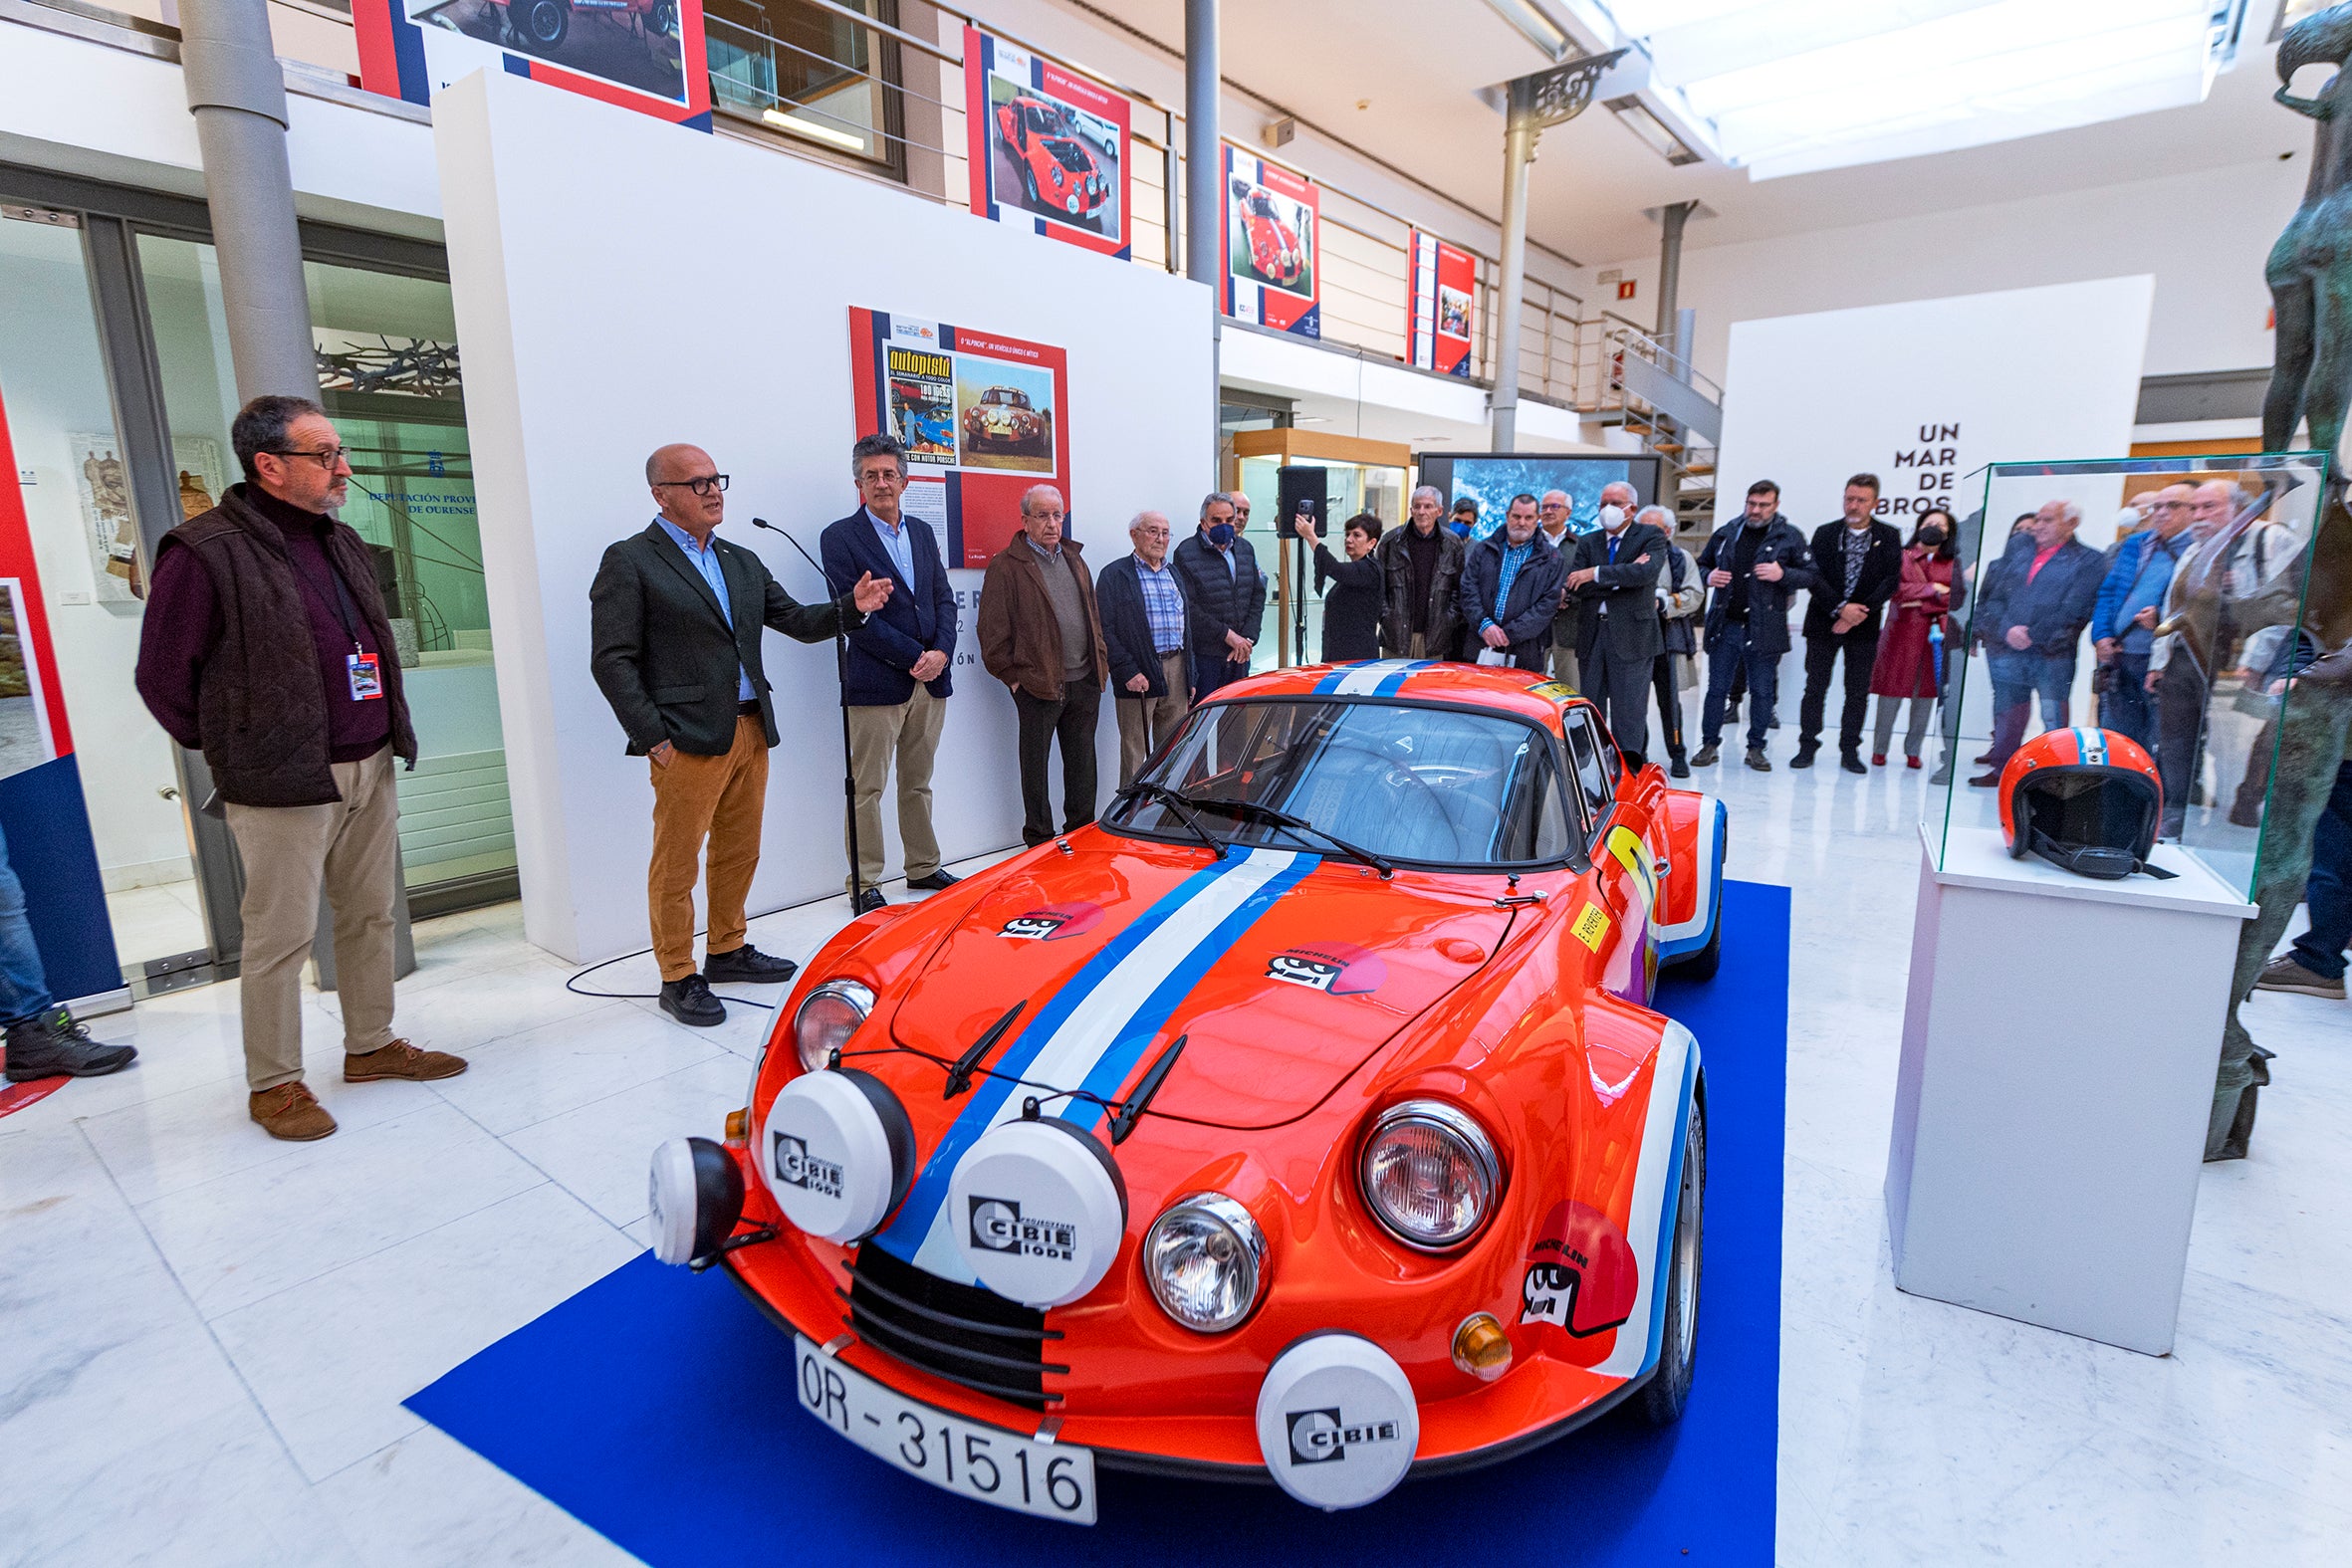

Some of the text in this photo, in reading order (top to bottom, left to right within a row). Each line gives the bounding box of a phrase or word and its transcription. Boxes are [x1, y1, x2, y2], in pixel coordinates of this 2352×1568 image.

[890, 350, 951, 377] autopista
[1920, 422, 1960, 442] UN
[936, 456, 955, 465] PORSCHE
[1894, 448, 1956, 468] MAR
[1919, 472, 1955, 490] DE
[369, 492, 441, 503] DEPUTACIÓN
[425, 506, 475, 515] OURENSE
[1286, 949, 1350, 968] MICHELIN
[788, 1155, 840, 1186] CIBIE
[990, 1221, 1071, 1246] CIBIE
[1024, 1243, 1072, 1261] IODE
[1532, 1237, 1589, 1269] MICHELIN
[1310, 1424, 1394, 1447] CIBIE
